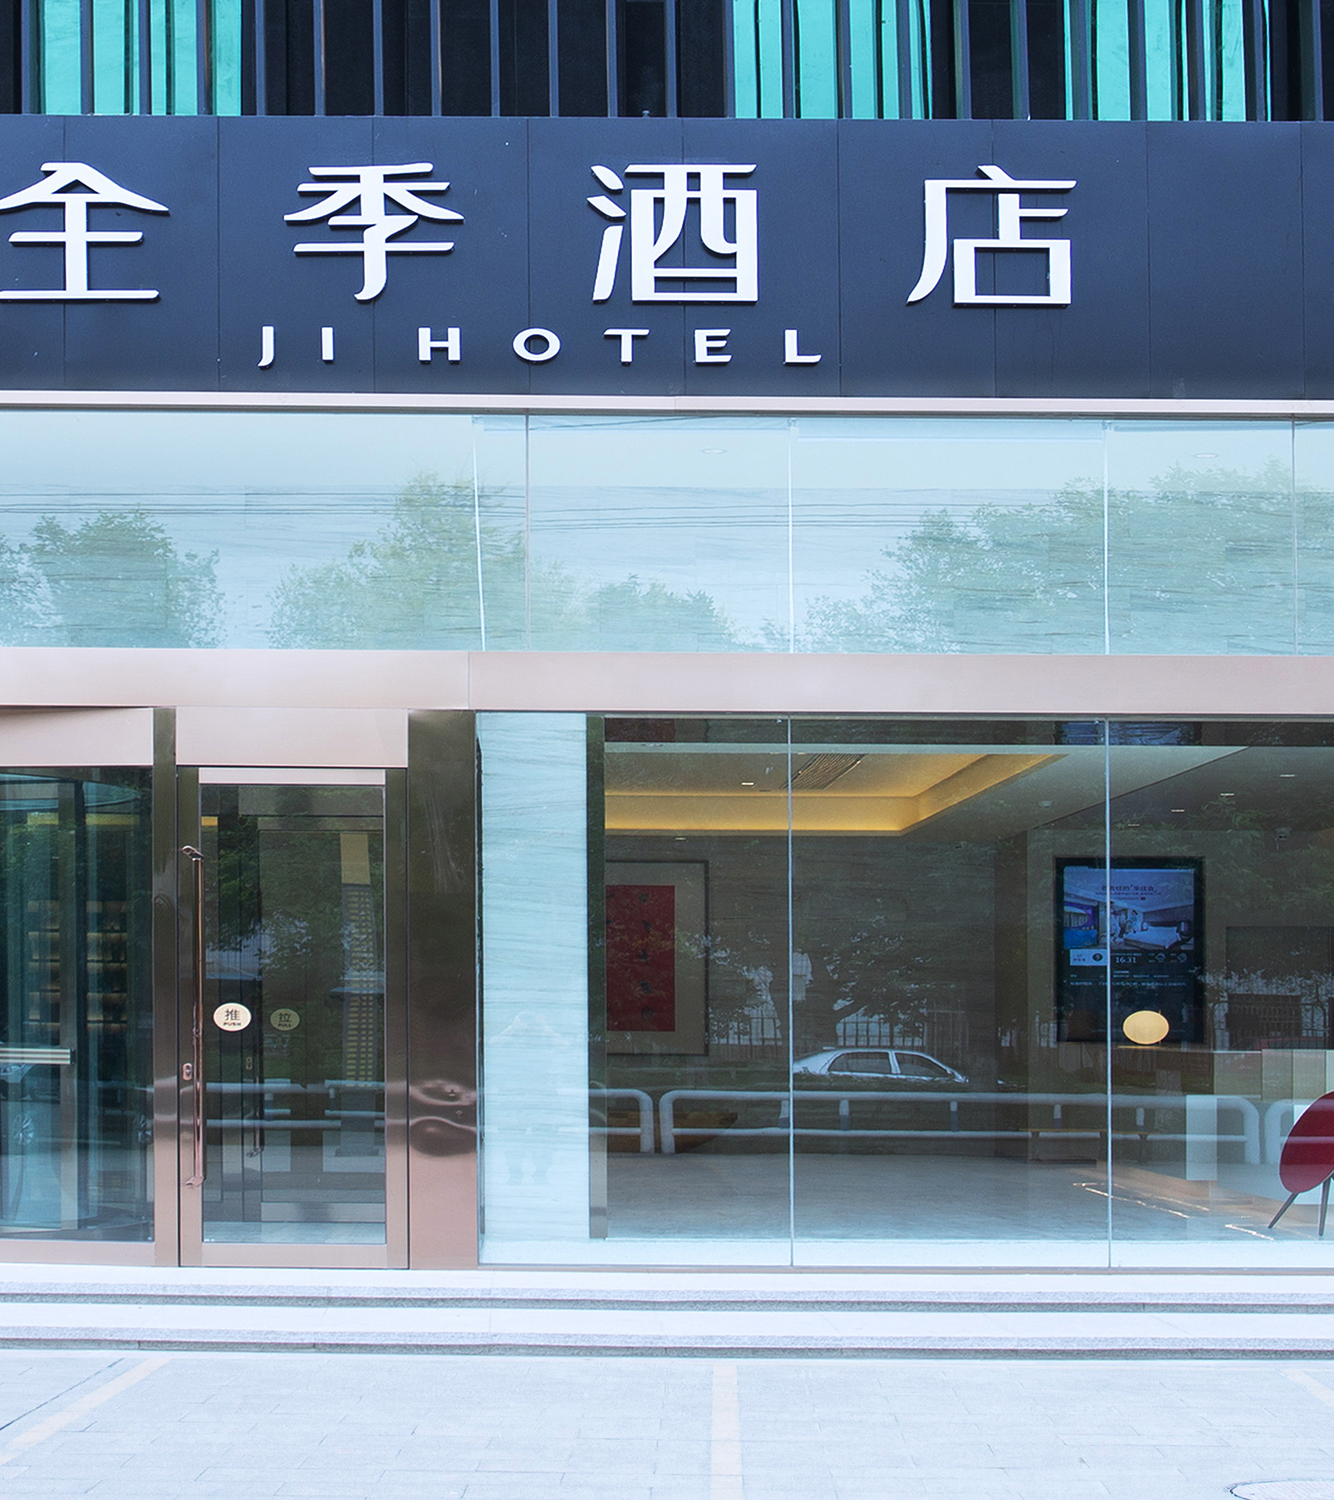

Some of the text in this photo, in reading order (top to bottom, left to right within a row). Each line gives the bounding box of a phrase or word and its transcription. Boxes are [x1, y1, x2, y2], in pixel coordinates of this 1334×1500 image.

[258, 326, 822, 367] JI HOTEL
[224, 1008, 241, 1021] 推
